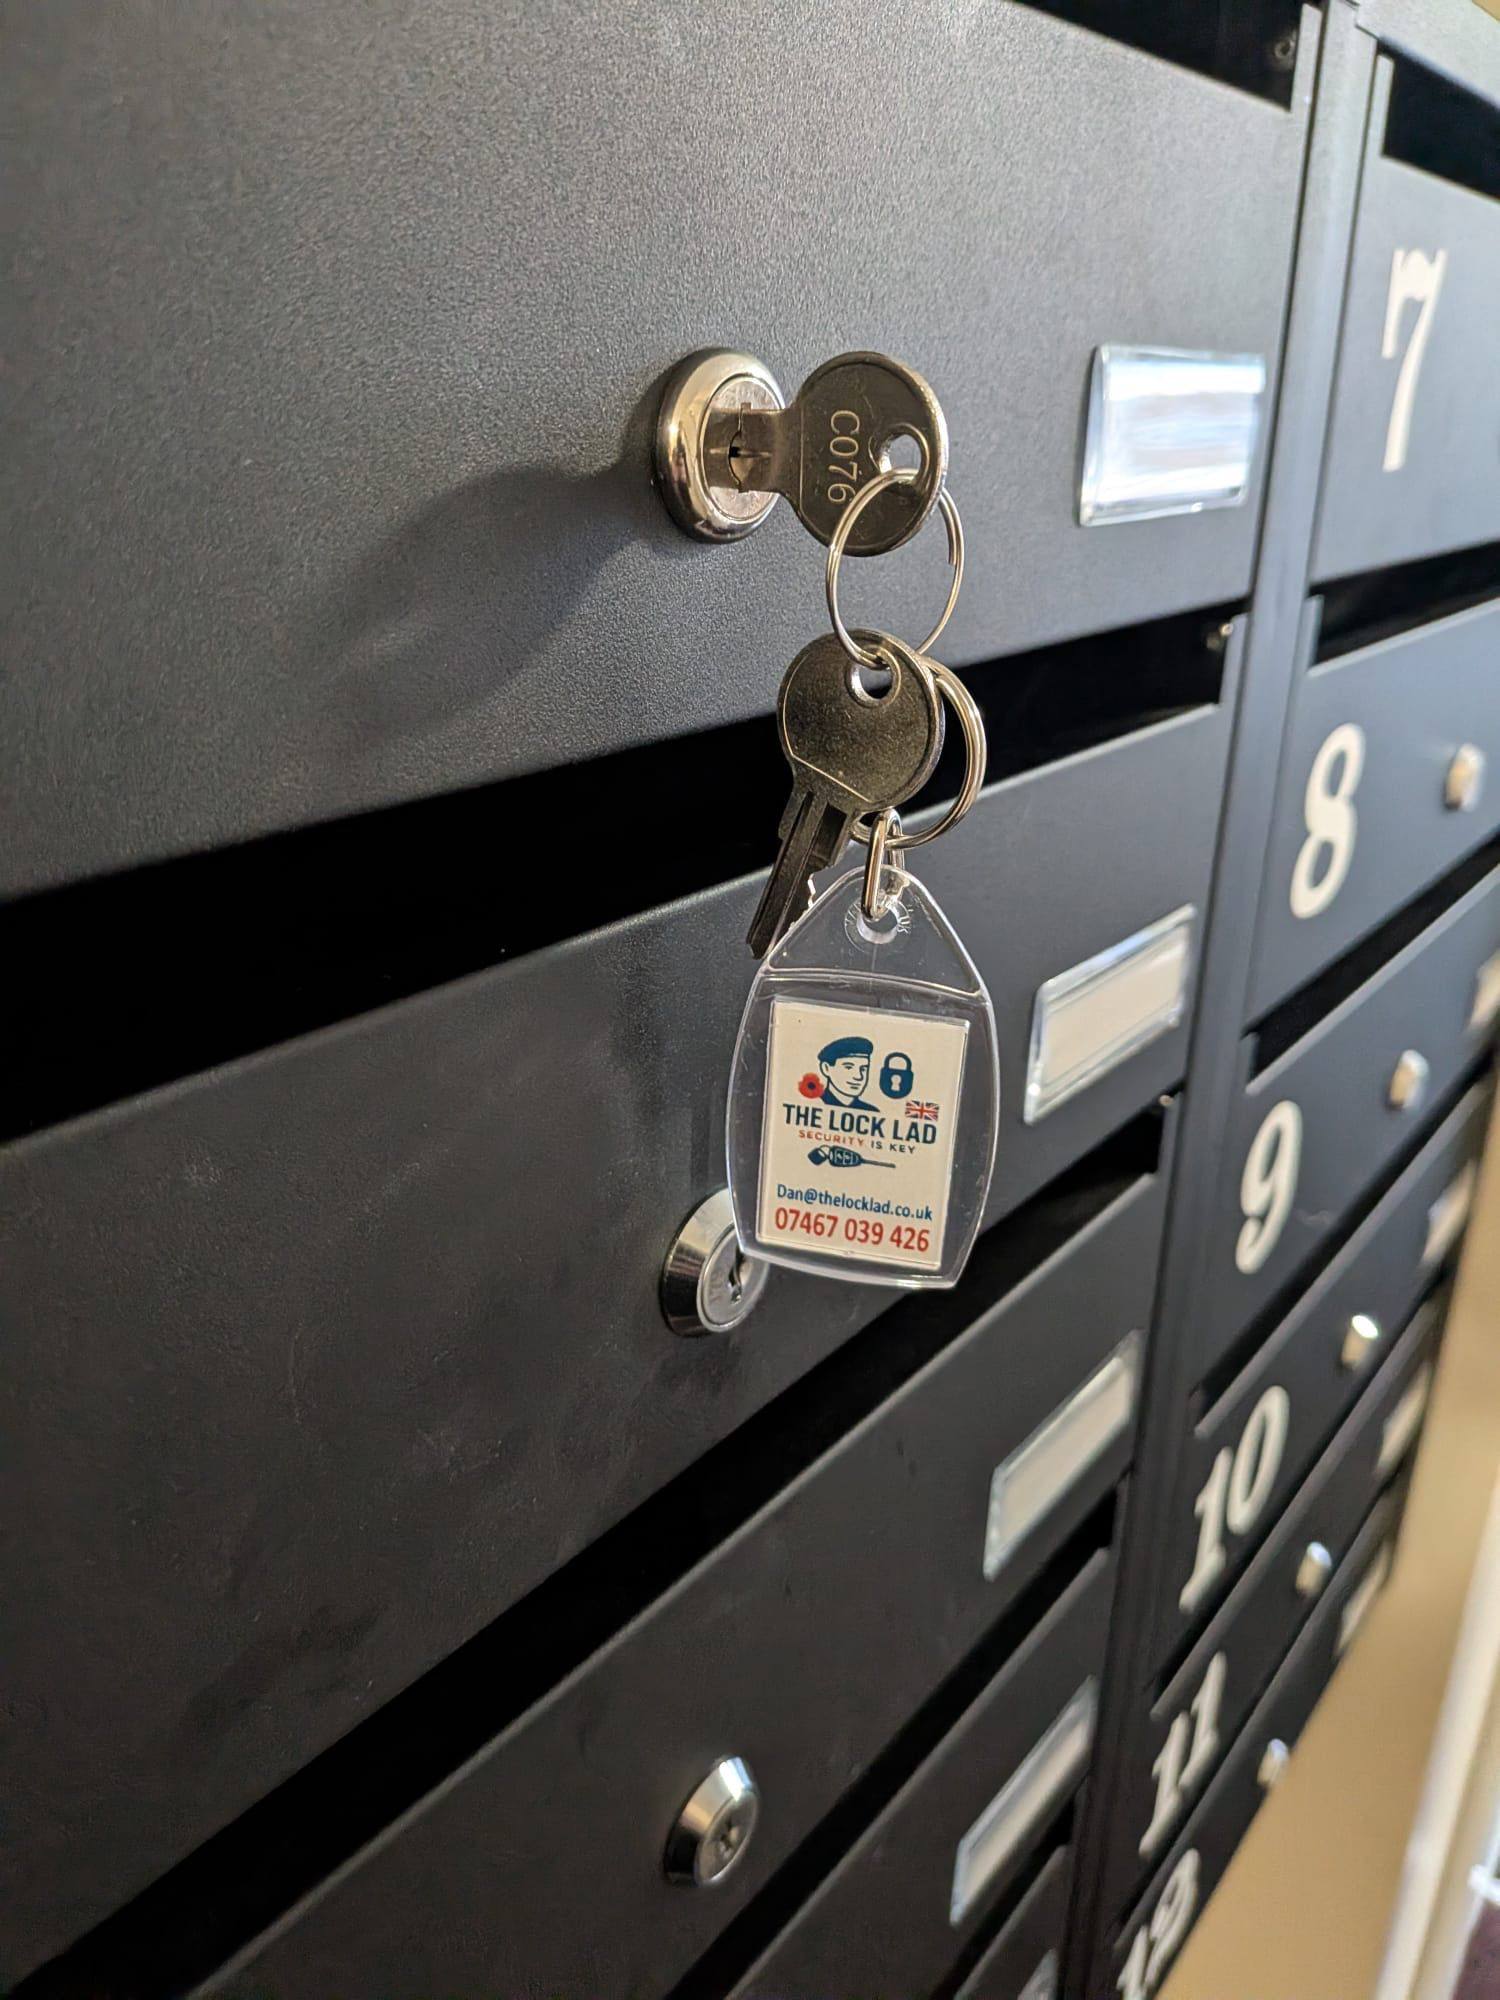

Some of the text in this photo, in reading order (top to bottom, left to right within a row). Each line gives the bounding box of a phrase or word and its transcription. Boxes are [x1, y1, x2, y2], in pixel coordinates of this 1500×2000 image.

[1380, 247, 1448, 474] 7
[827, 409, 861, 503] C076
[1289, 721, 1366, 919] 8
[783, 1103, 937, 1145] THE LOCK LAD
[798, 1129, 916, 1155] SECURITY IS KEY
[1234, 1099, 1303, 1275] 9
[774, 1206, 931, 1253] 07467 039 426
[776, 1183, 933, 1222] Dan@thelocklad.co.uk
[1178, 1384, 1291, 1613] 10
[1138, 1650, 1229, 1860] 11
